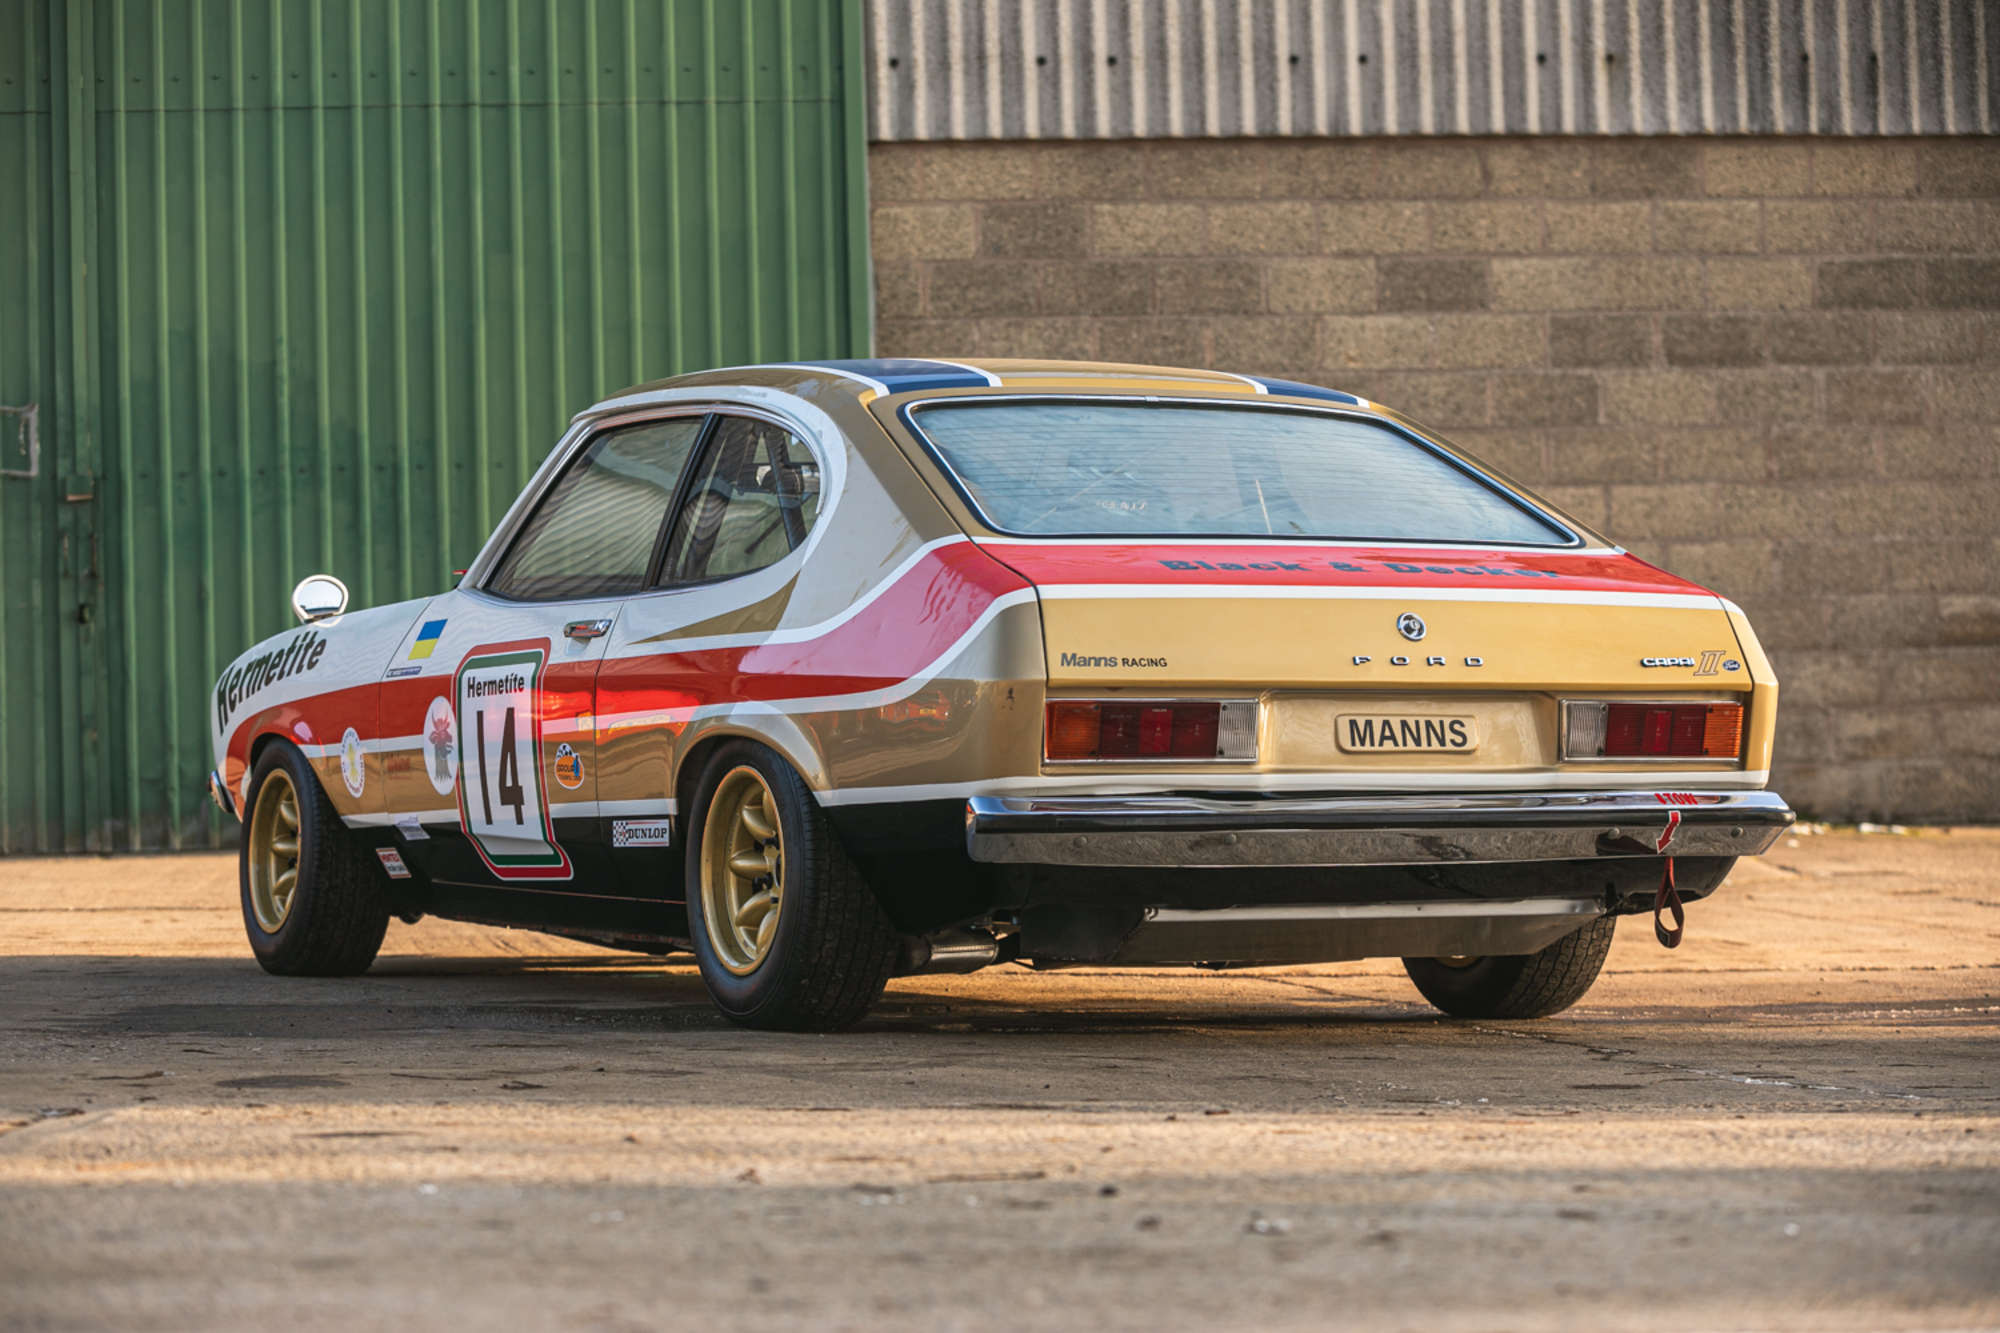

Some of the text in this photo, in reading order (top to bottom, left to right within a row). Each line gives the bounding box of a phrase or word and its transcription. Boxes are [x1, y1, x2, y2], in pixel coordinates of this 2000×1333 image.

[1158, 560, 1560, 578] Black & Decker
[1060, 651, 1168, 668] Manns RACING
[1352, 655, 1485, 667] FORD
[216, 630, 327, 737] Hermetite
[466, 672, 525, 699] Hermetite
[1348, 719, 1468, 748] MANNS
[476, 706, 525, 826] 14
[627, 827, 668, 839] DUNLOP
